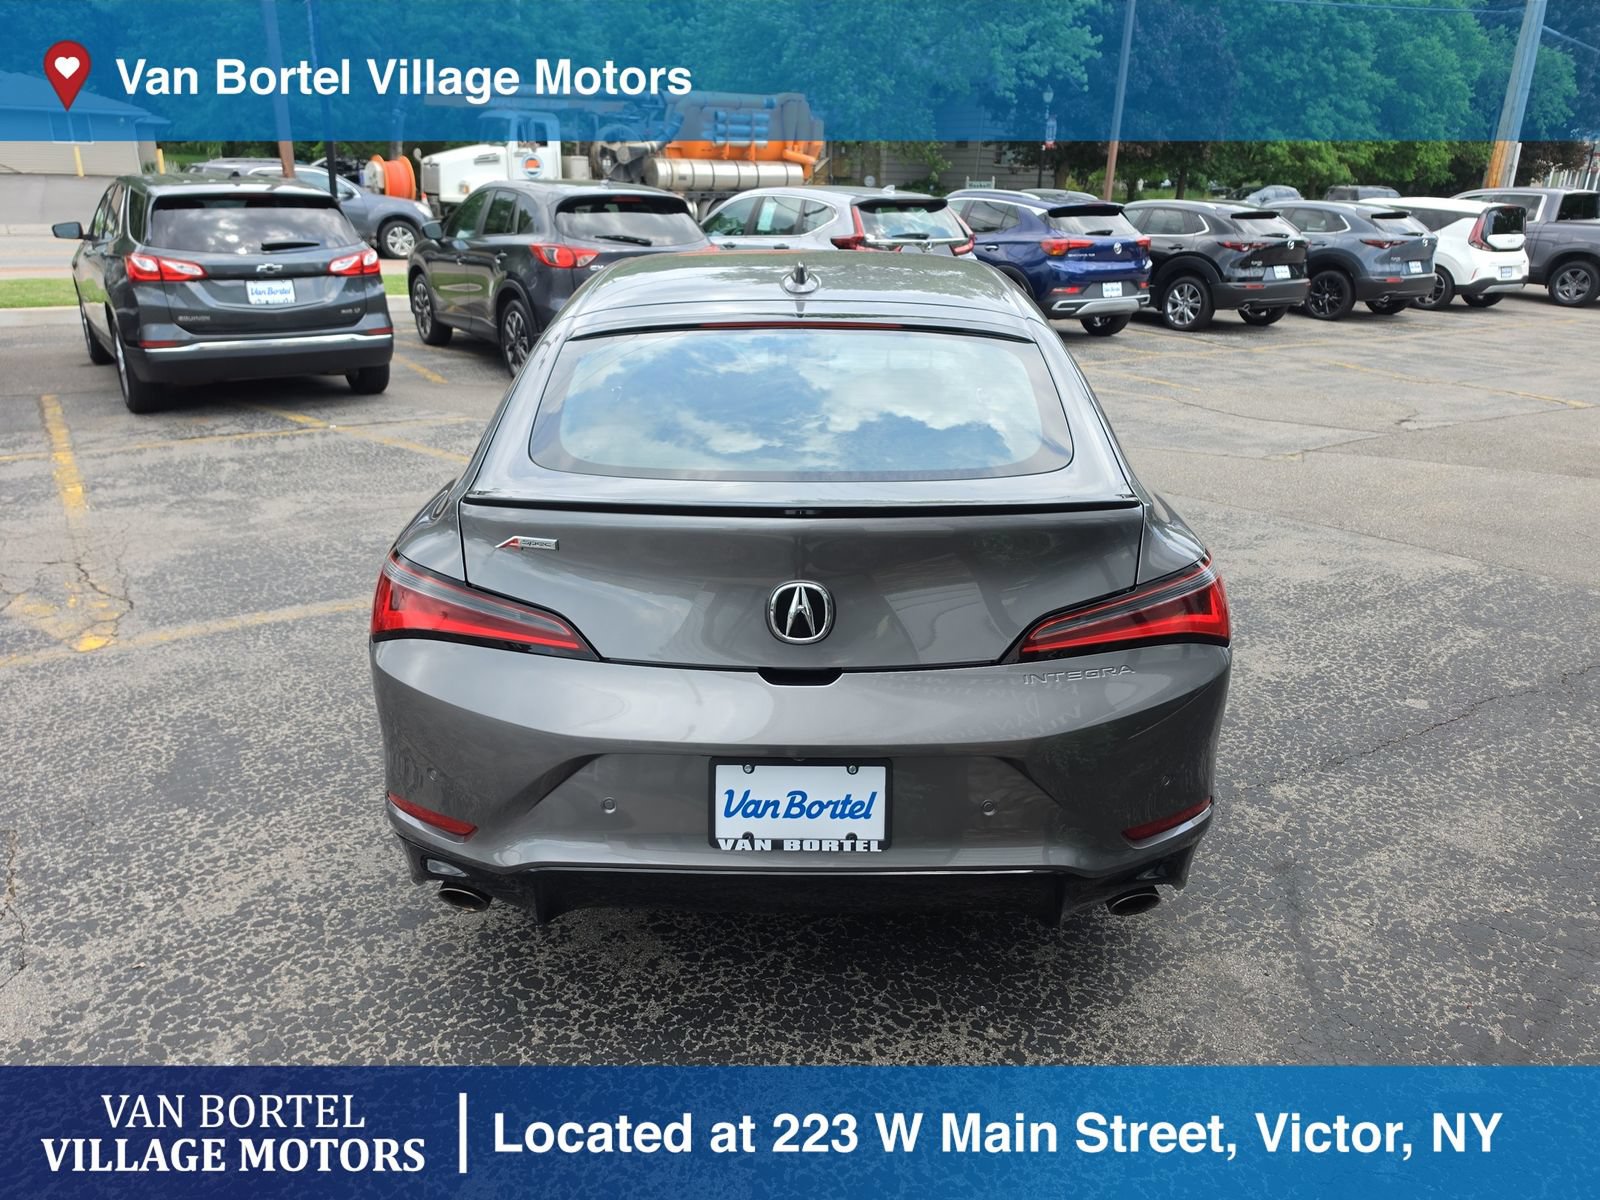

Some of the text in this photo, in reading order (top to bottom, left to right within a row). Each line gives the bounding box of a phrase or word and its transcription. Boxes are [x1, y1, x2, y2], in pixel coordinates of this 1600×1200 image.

[1023, 664, 1136, 685] INTEGRA
[723, 788, 878, 820] Van Bortel
[717, 838, 883, 853] VAN BORTEL
